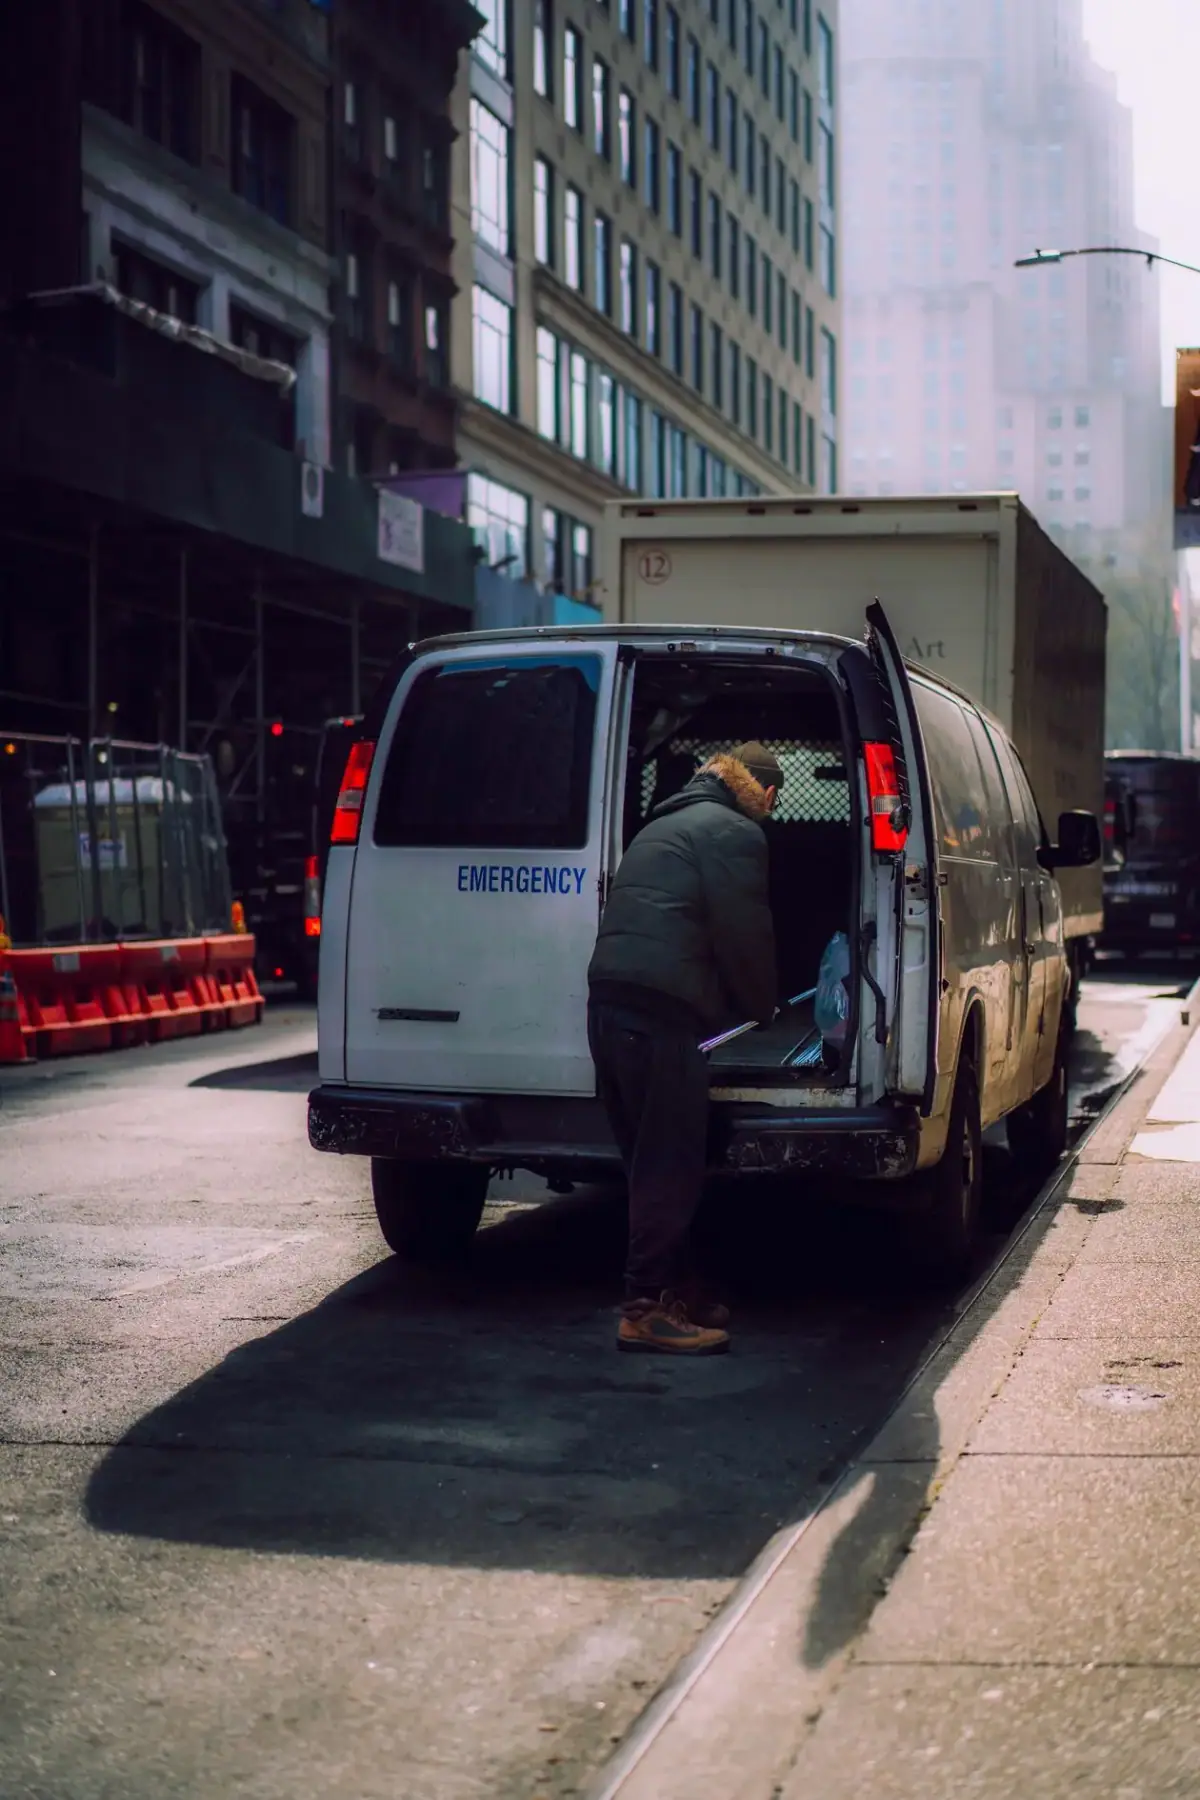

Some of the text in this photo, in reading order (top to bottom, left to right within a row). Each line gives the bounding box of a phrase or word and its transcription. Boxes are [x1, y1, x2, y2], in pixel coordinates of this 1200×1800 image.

[645, 556, 667, 578] 12
[904, 637, 945, 658] Art
[457, 864, 587, 895] EMERGENCY
